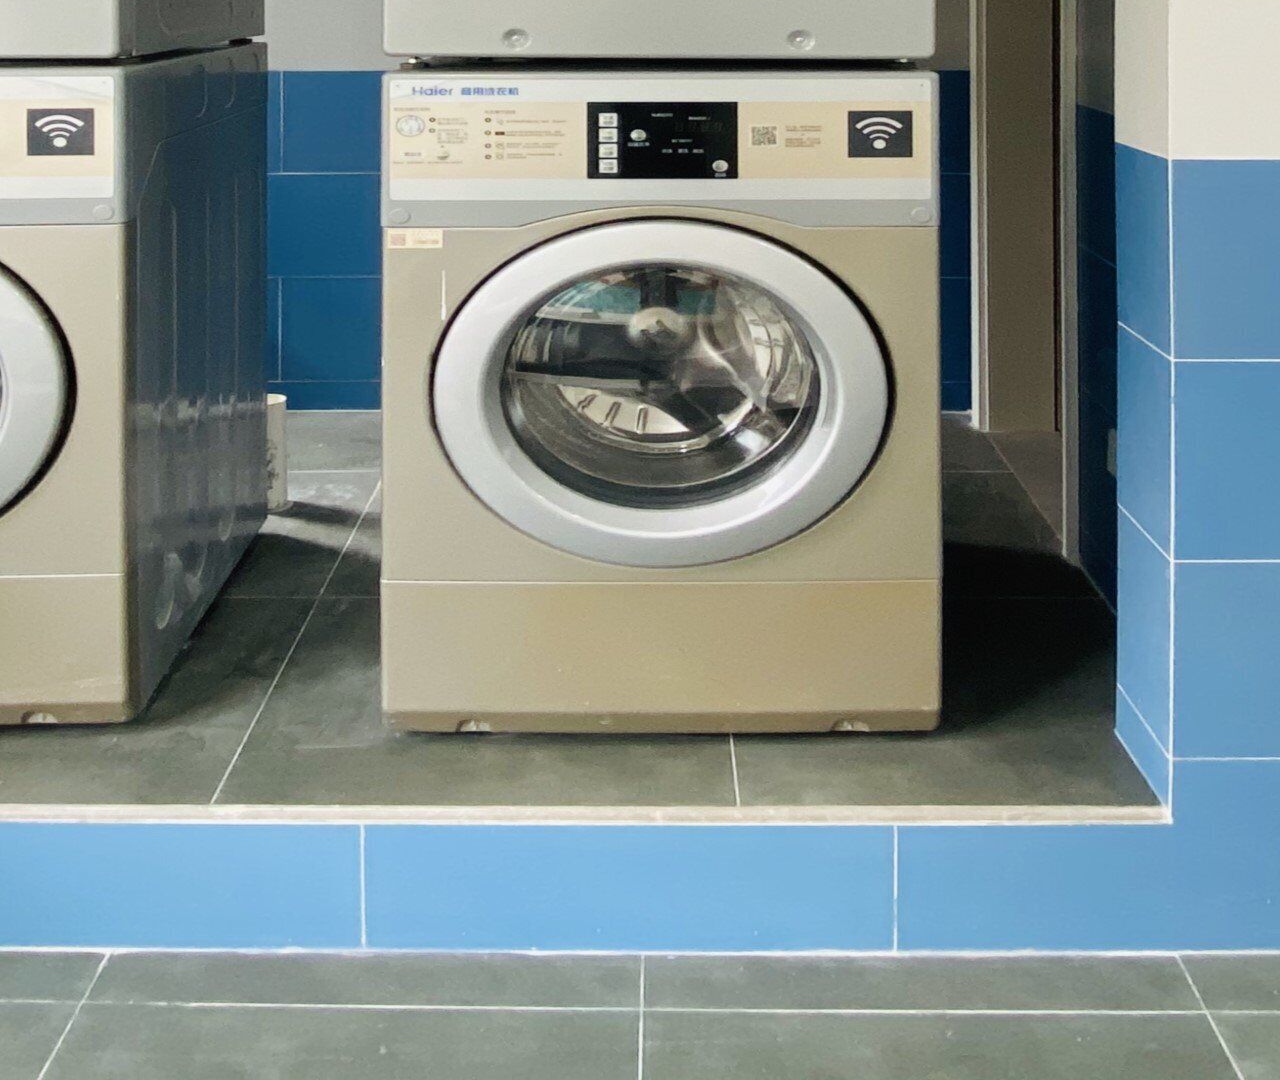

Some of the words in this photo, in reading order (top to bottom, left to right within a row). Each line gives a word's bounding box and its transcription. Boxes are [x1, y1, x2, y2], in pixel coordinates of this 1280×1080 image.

[412, 85, 454, 96] Haier
[461, 86, 519, 96] 商用洗衣机
